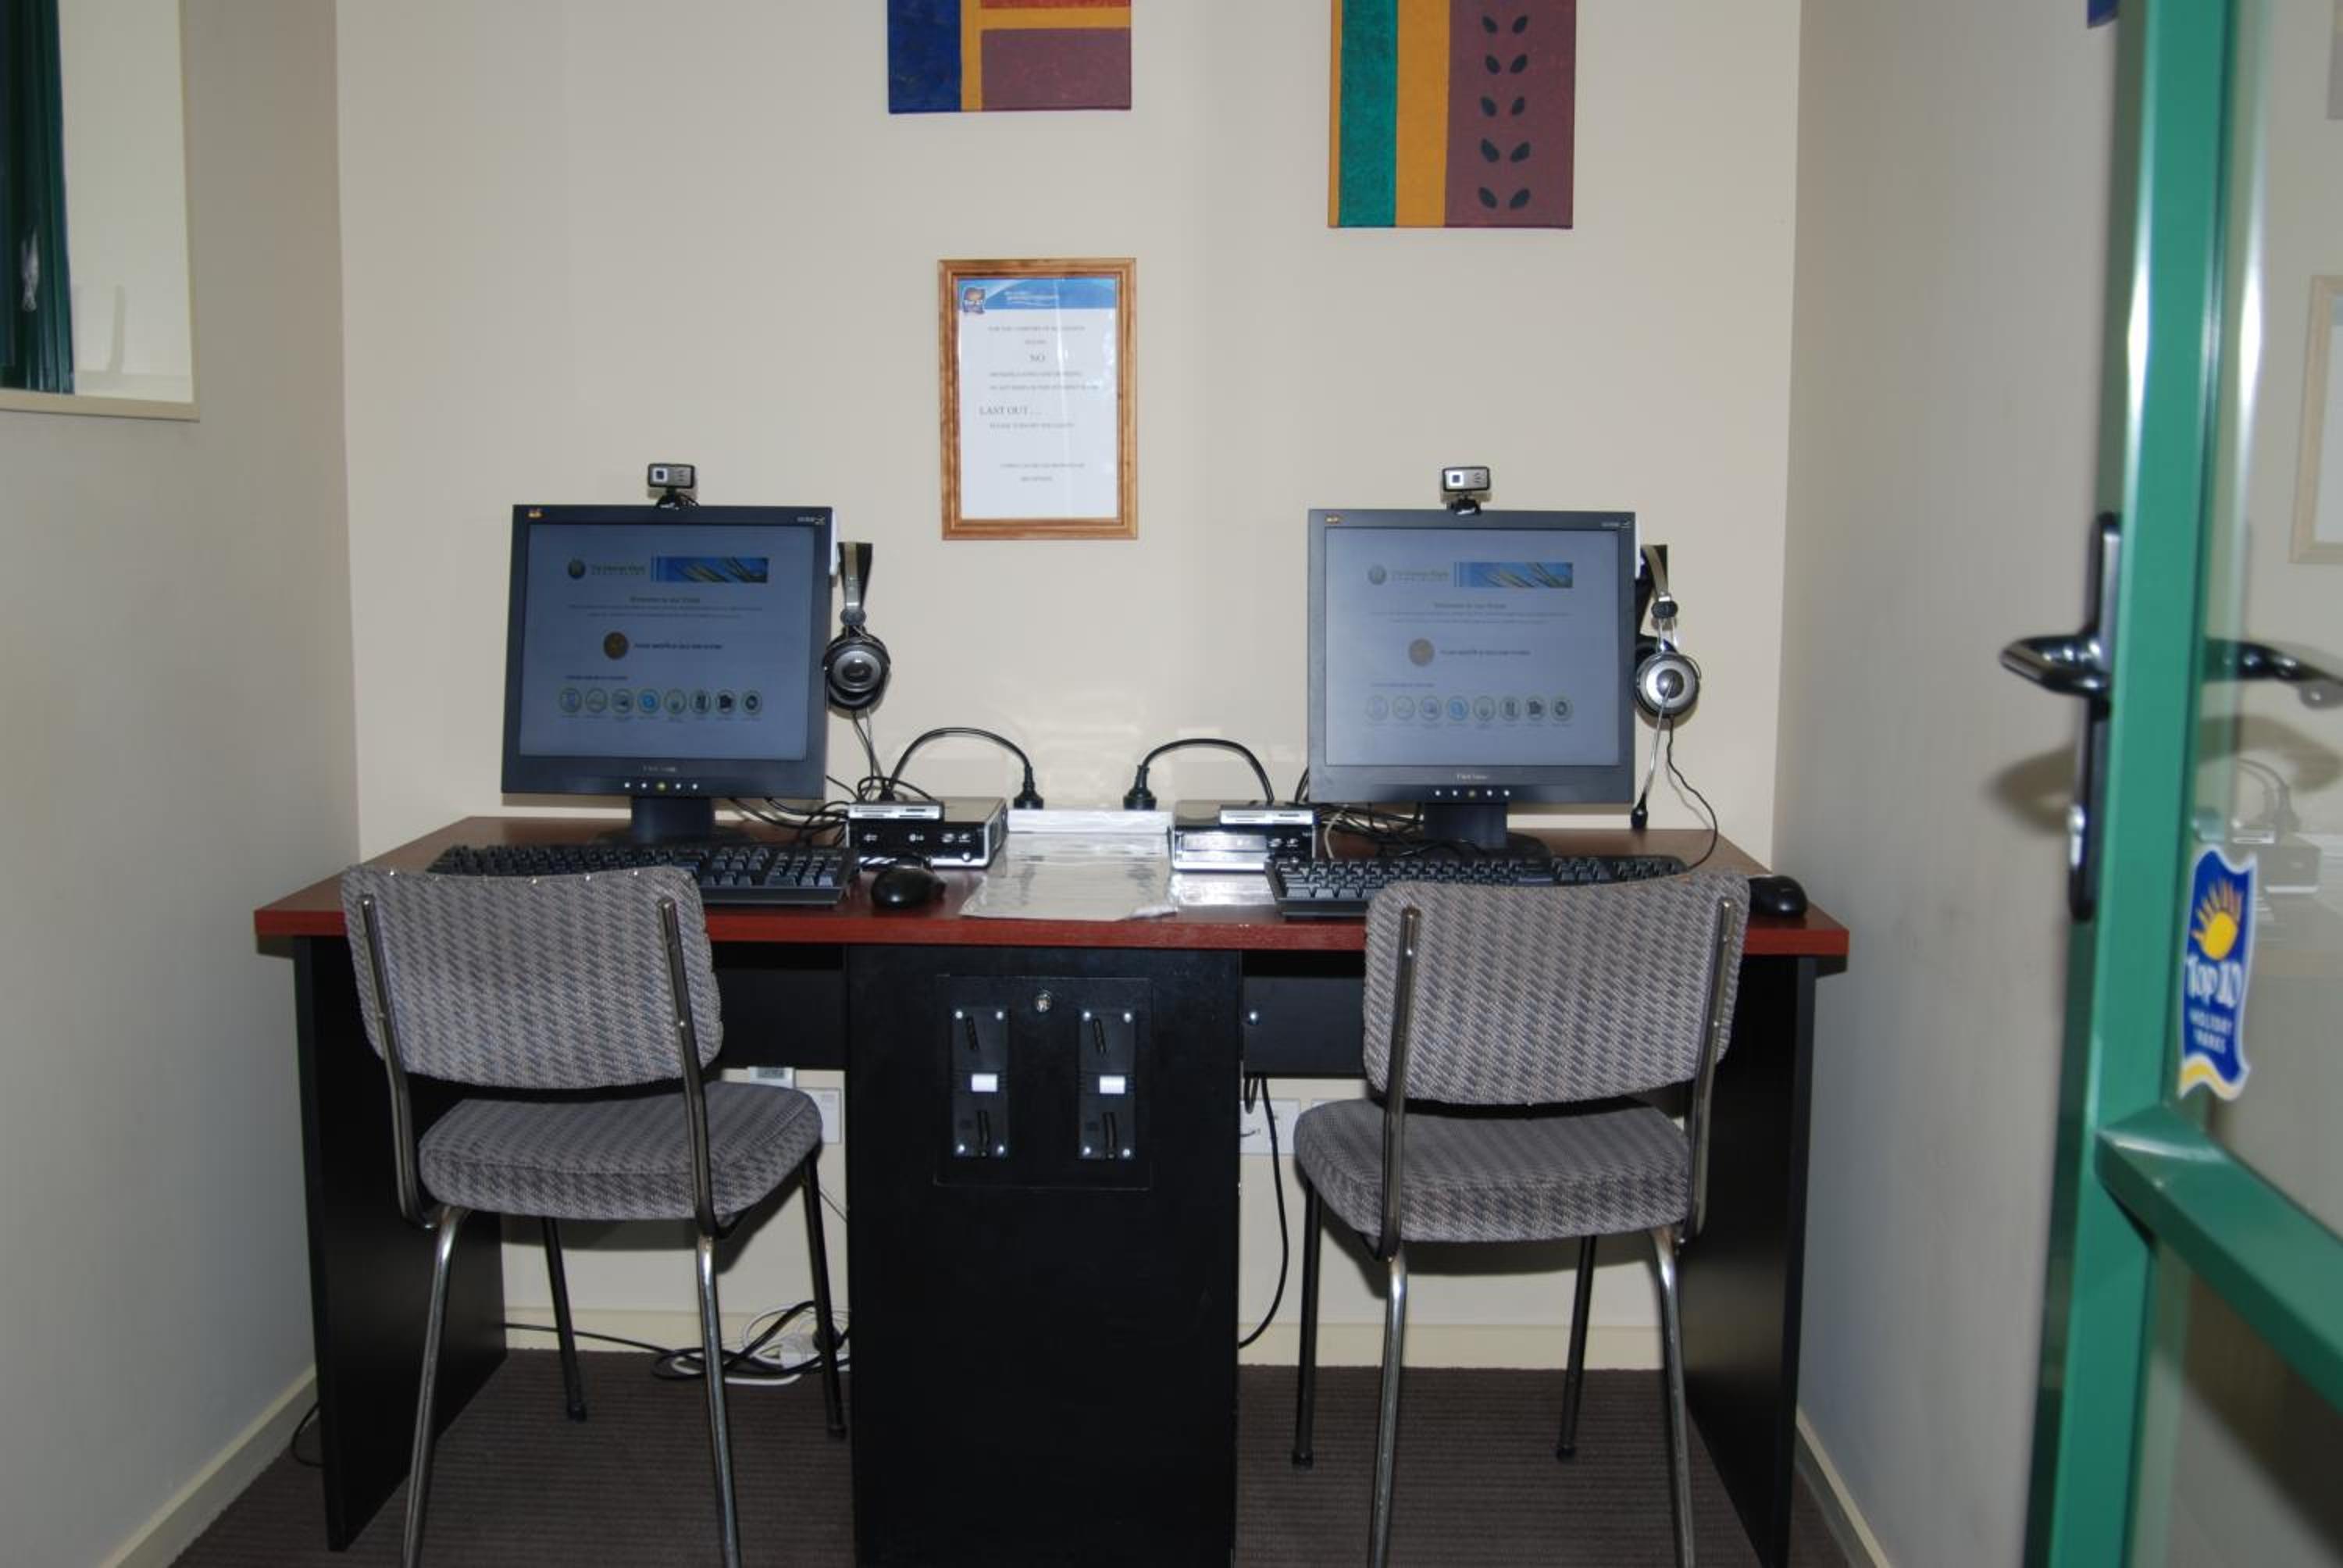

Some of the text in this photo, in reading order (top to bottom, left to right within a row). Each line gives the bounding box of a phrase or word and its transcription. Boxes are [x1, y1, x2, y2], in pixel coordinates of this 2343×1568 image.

[979, 405, 1028, 415] LAST OUT
[2186, 954, 2218, 1006] Top
